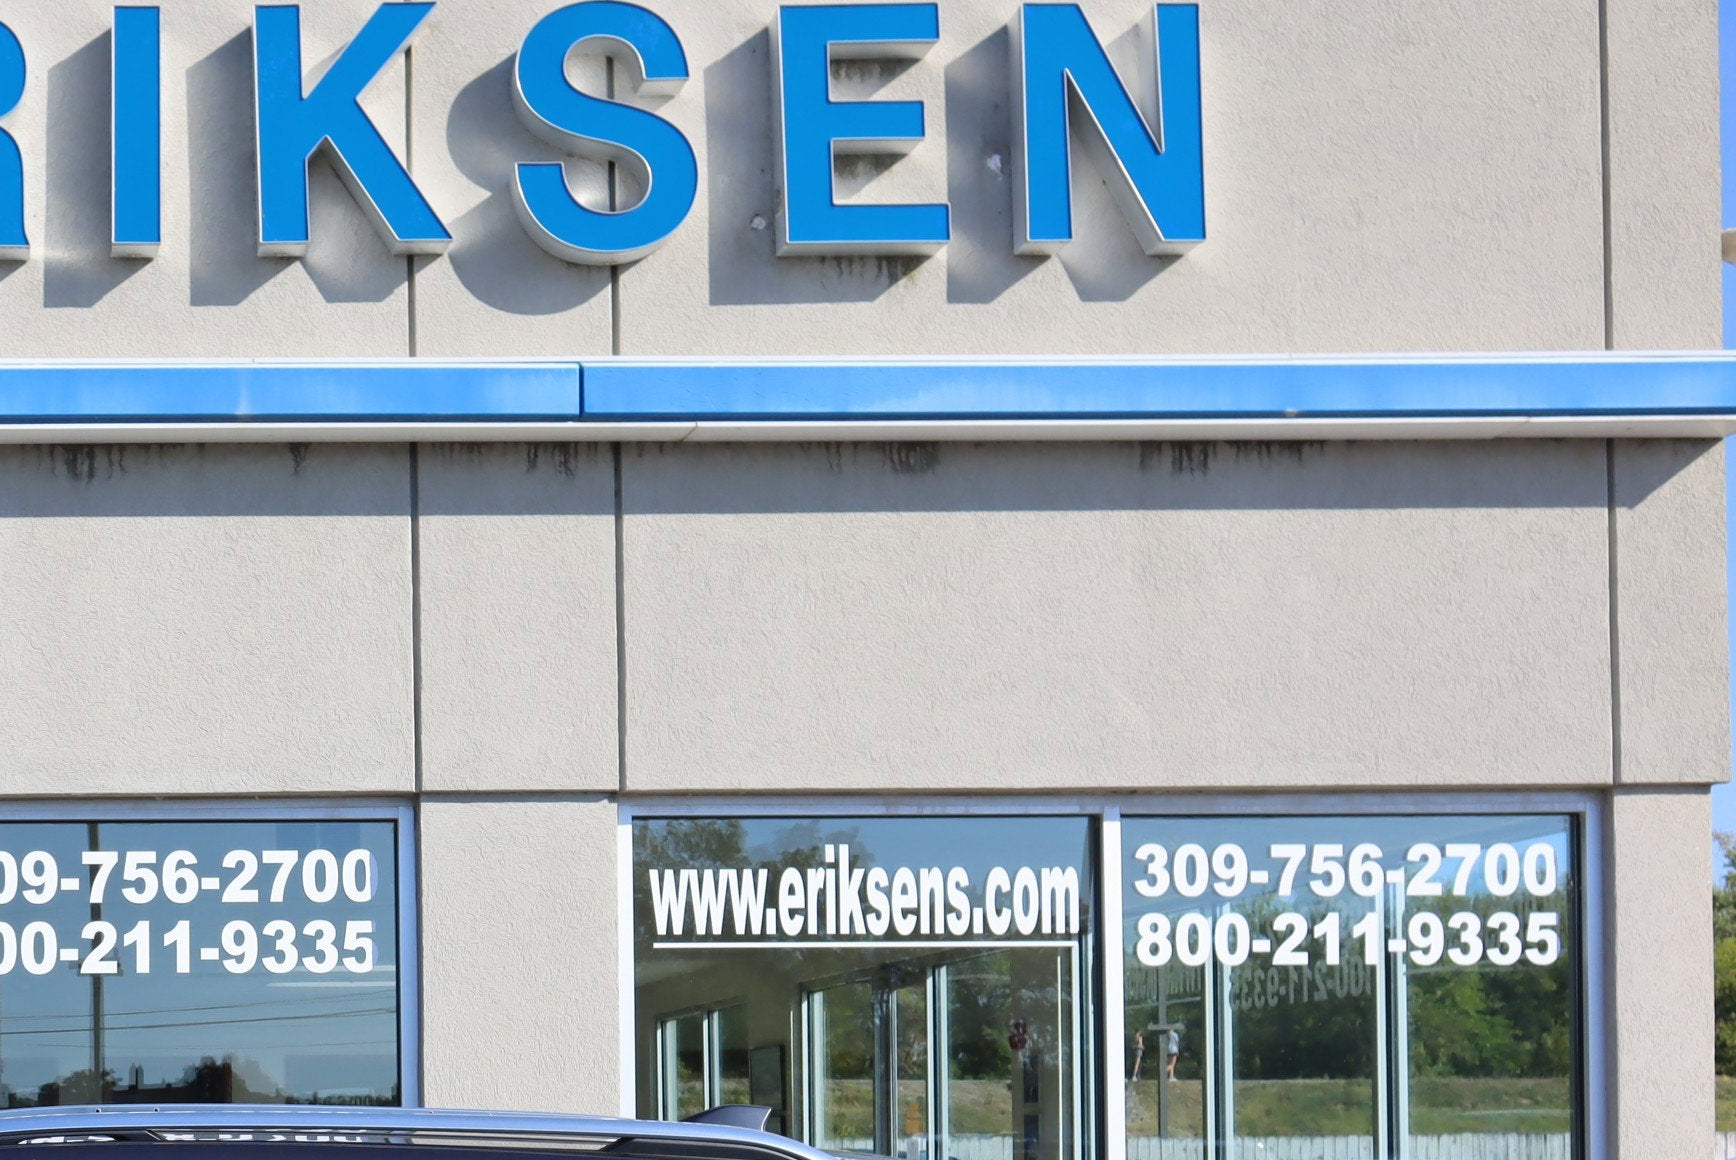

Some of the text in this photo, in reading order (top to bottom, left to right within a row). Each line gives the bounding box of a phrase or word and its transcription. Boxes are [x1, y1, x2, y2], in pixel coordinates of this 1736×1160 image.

[649, 843, 1080, 935] www.eriksens.com
[1133, 842, 1558, 899] 309-756-2700
[1135, 912, 1561, 967] 800-211-9335
